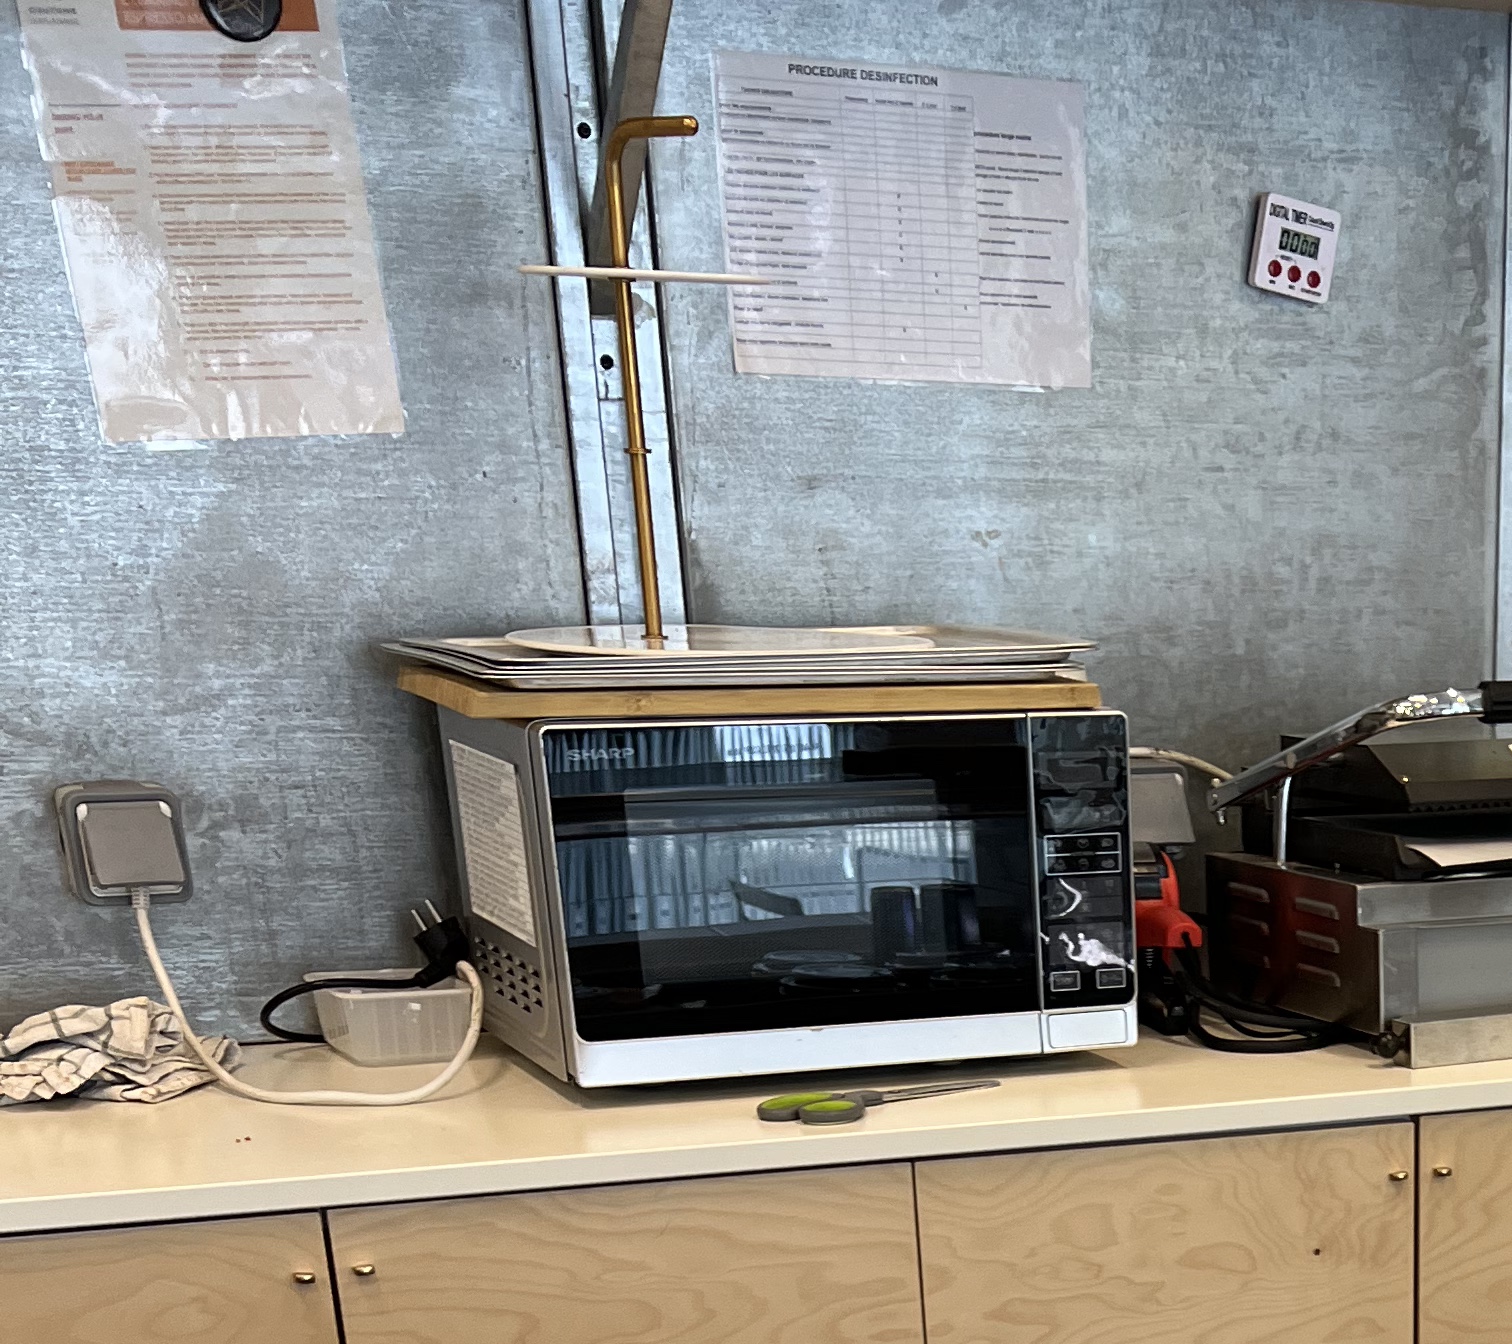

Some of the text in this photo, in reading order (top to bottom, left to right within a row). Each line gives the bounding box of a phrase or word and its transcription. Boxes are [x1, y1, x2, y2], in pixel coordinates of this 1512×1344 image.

[788, 63, 938, 87] PROCEDURE DESINFECTION
[566, 747, 635, 761] SHARP
